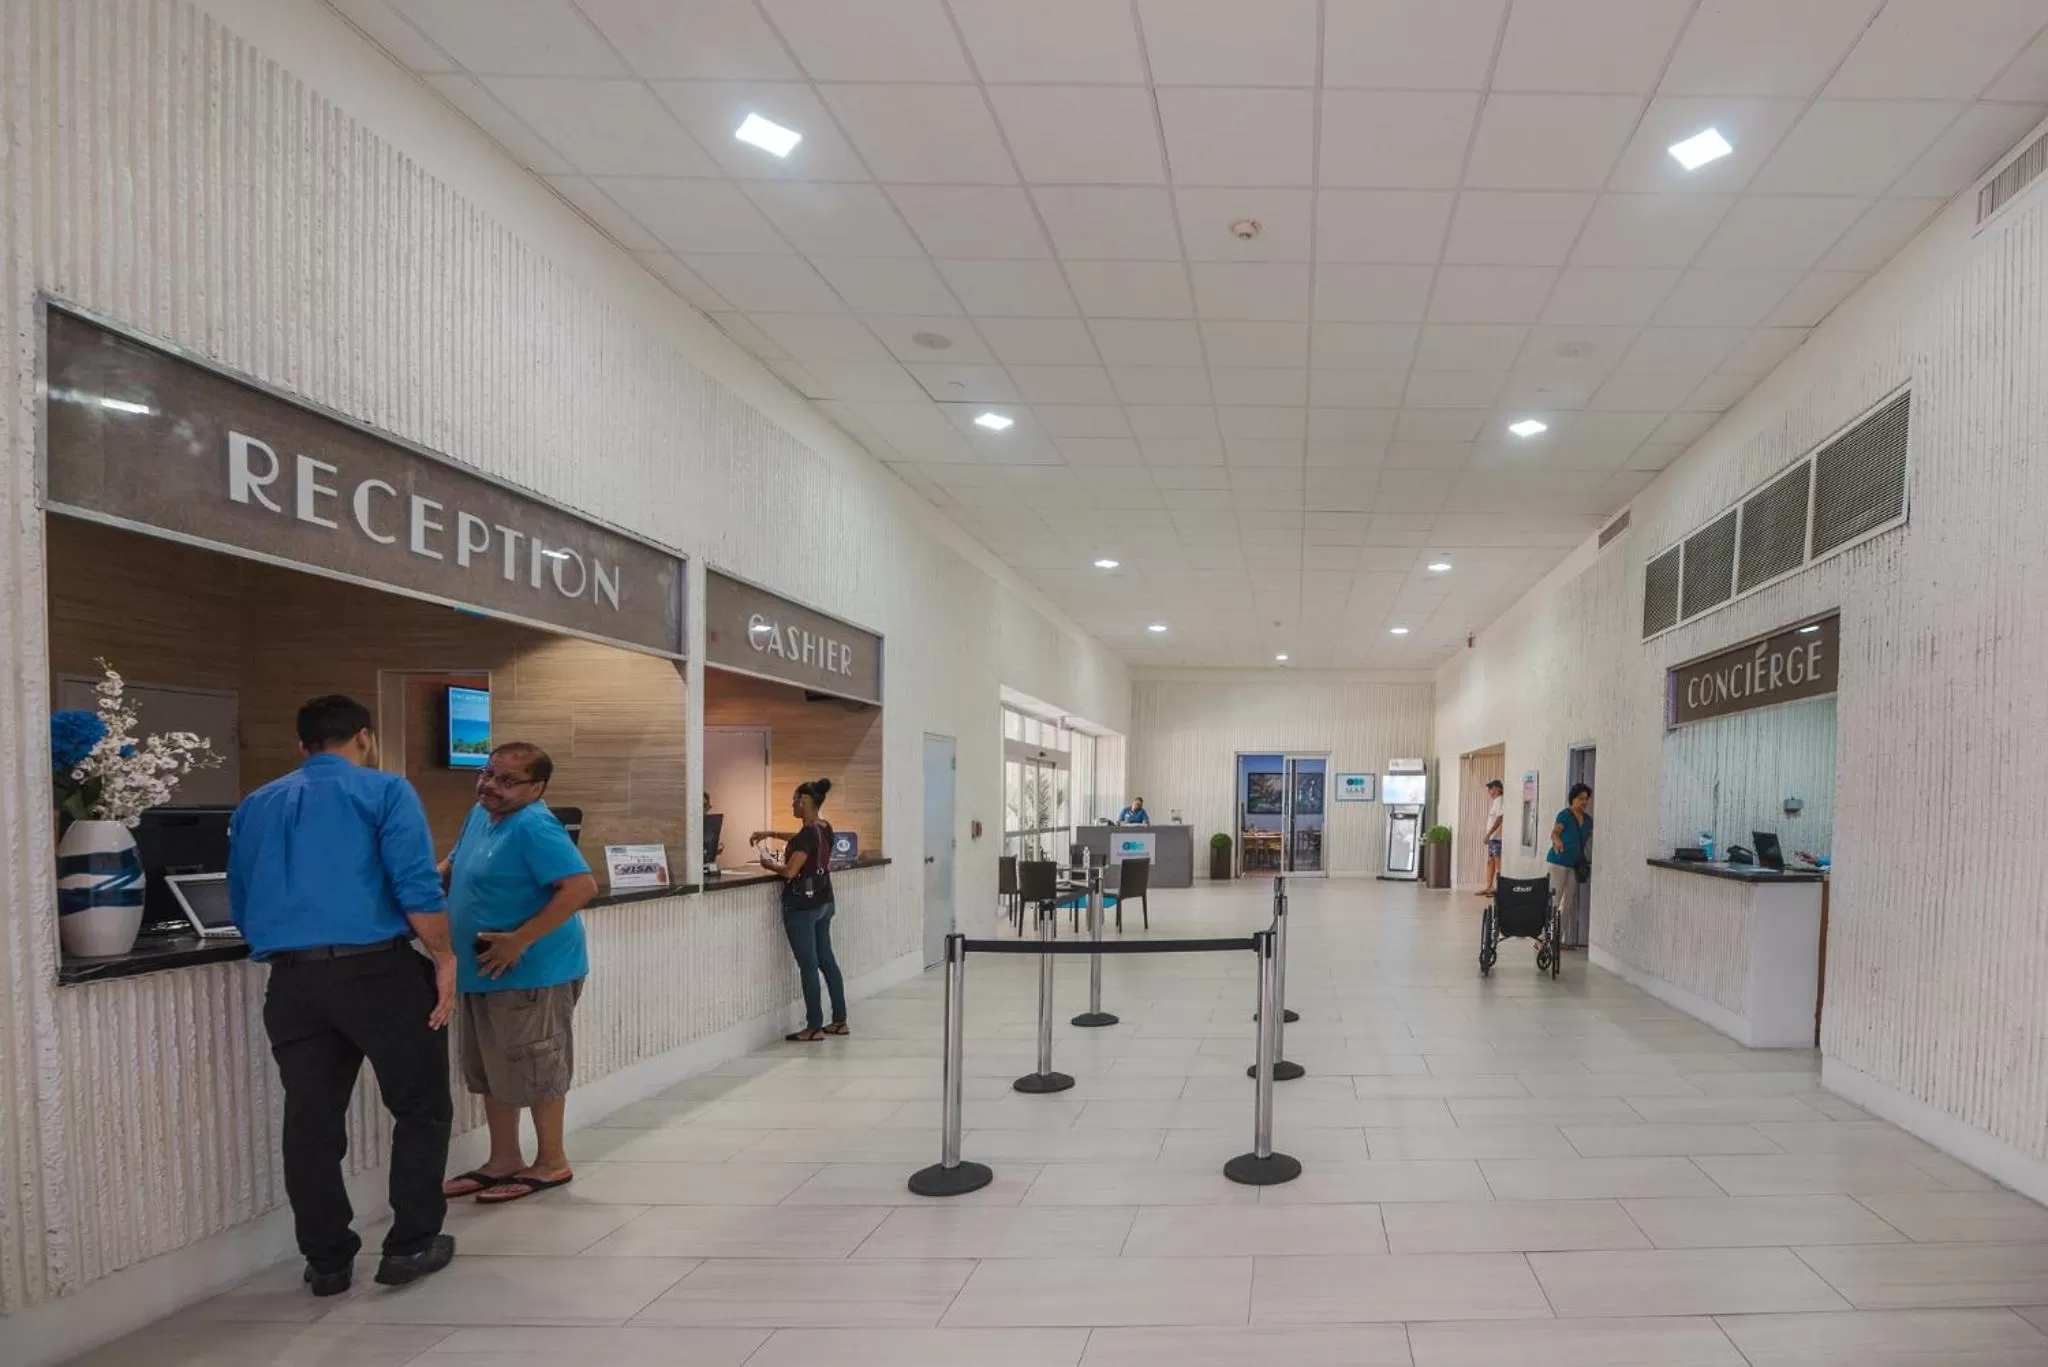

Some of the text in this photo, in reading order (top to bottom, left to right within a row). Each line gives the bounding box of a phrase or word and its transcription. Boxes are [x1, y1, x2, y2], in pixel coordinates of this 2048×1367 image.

[228, 430, 621, 611] RECEPTION
[747, 613, 852, 677] CASHIER
[1687, 640, 1823, 709] CONCIÉRGE
[622, 865, 655, 875] VISA
